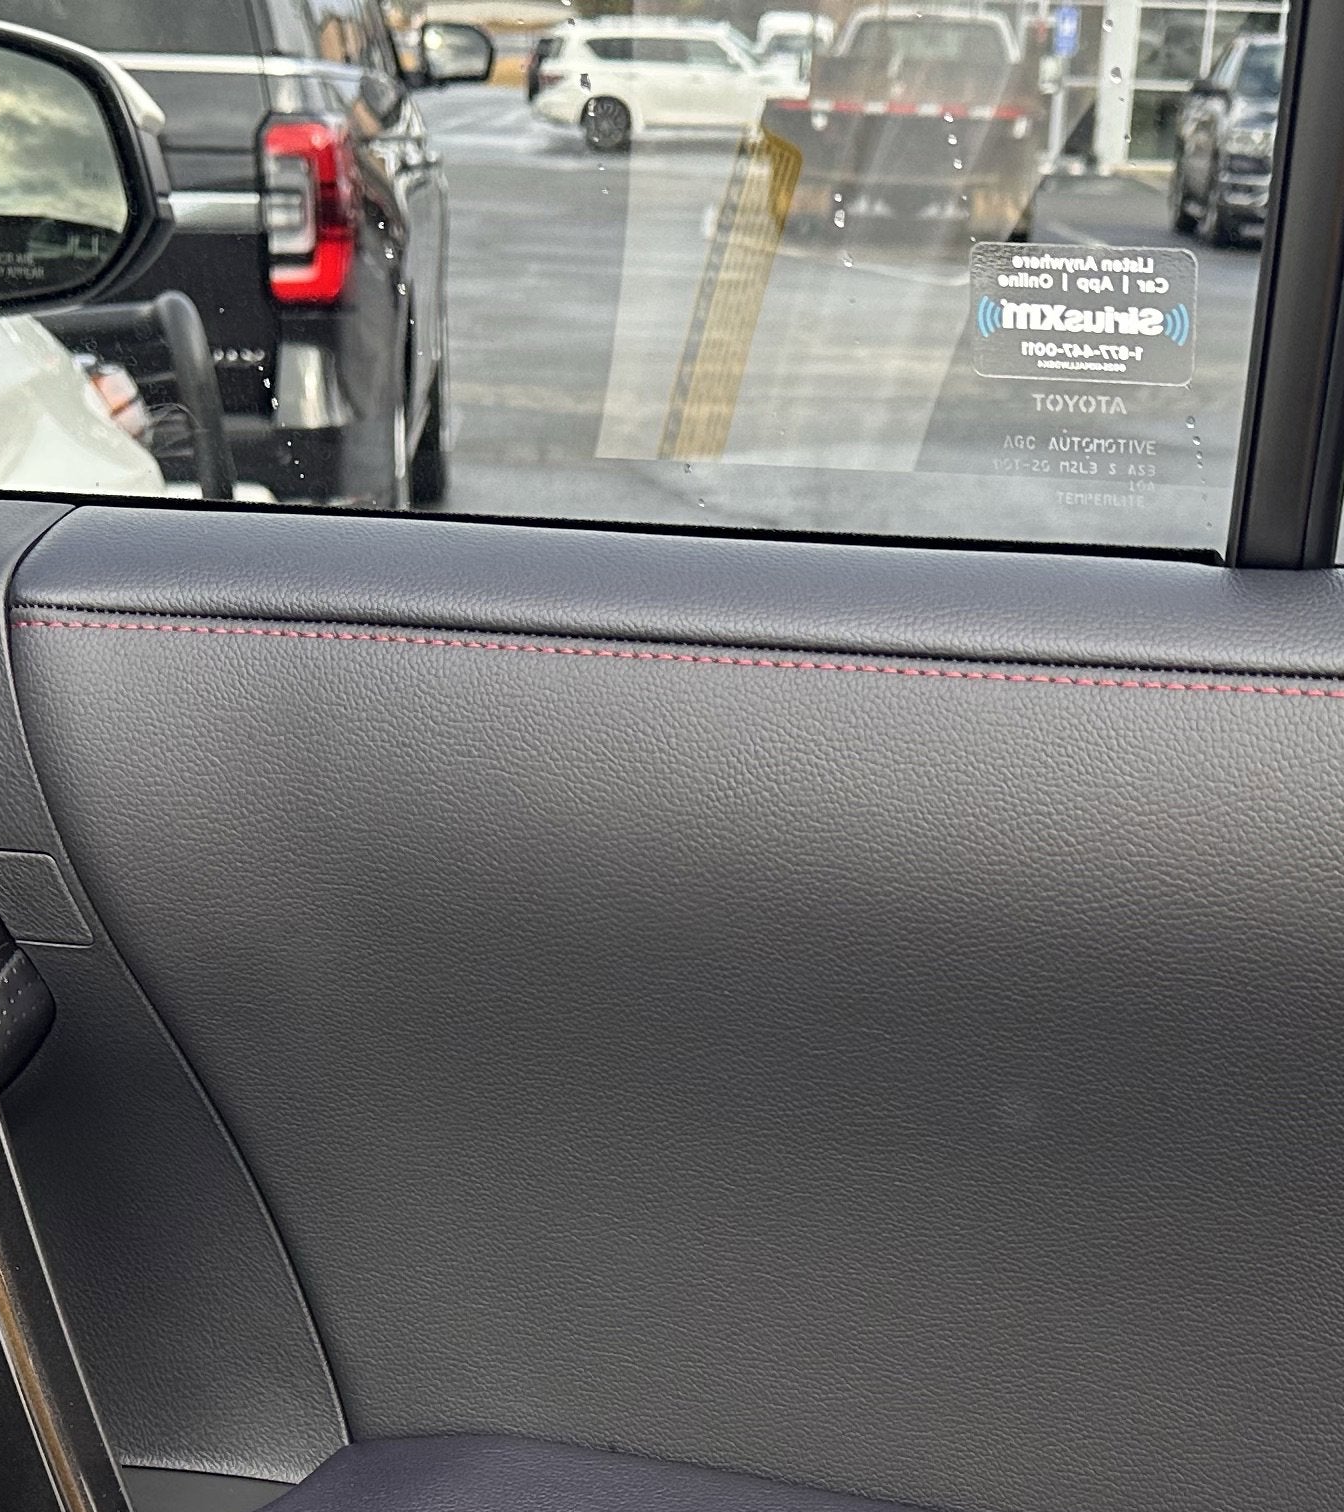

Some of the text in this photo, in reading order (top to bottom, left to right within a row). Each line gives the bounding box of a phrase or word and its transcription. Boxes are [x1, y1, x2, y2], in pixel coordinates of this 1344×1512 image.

[1032, 394, 1127, 415] TOYOTA
[1003, 434, 1156, 456] AGC AUTOMOTIVE
